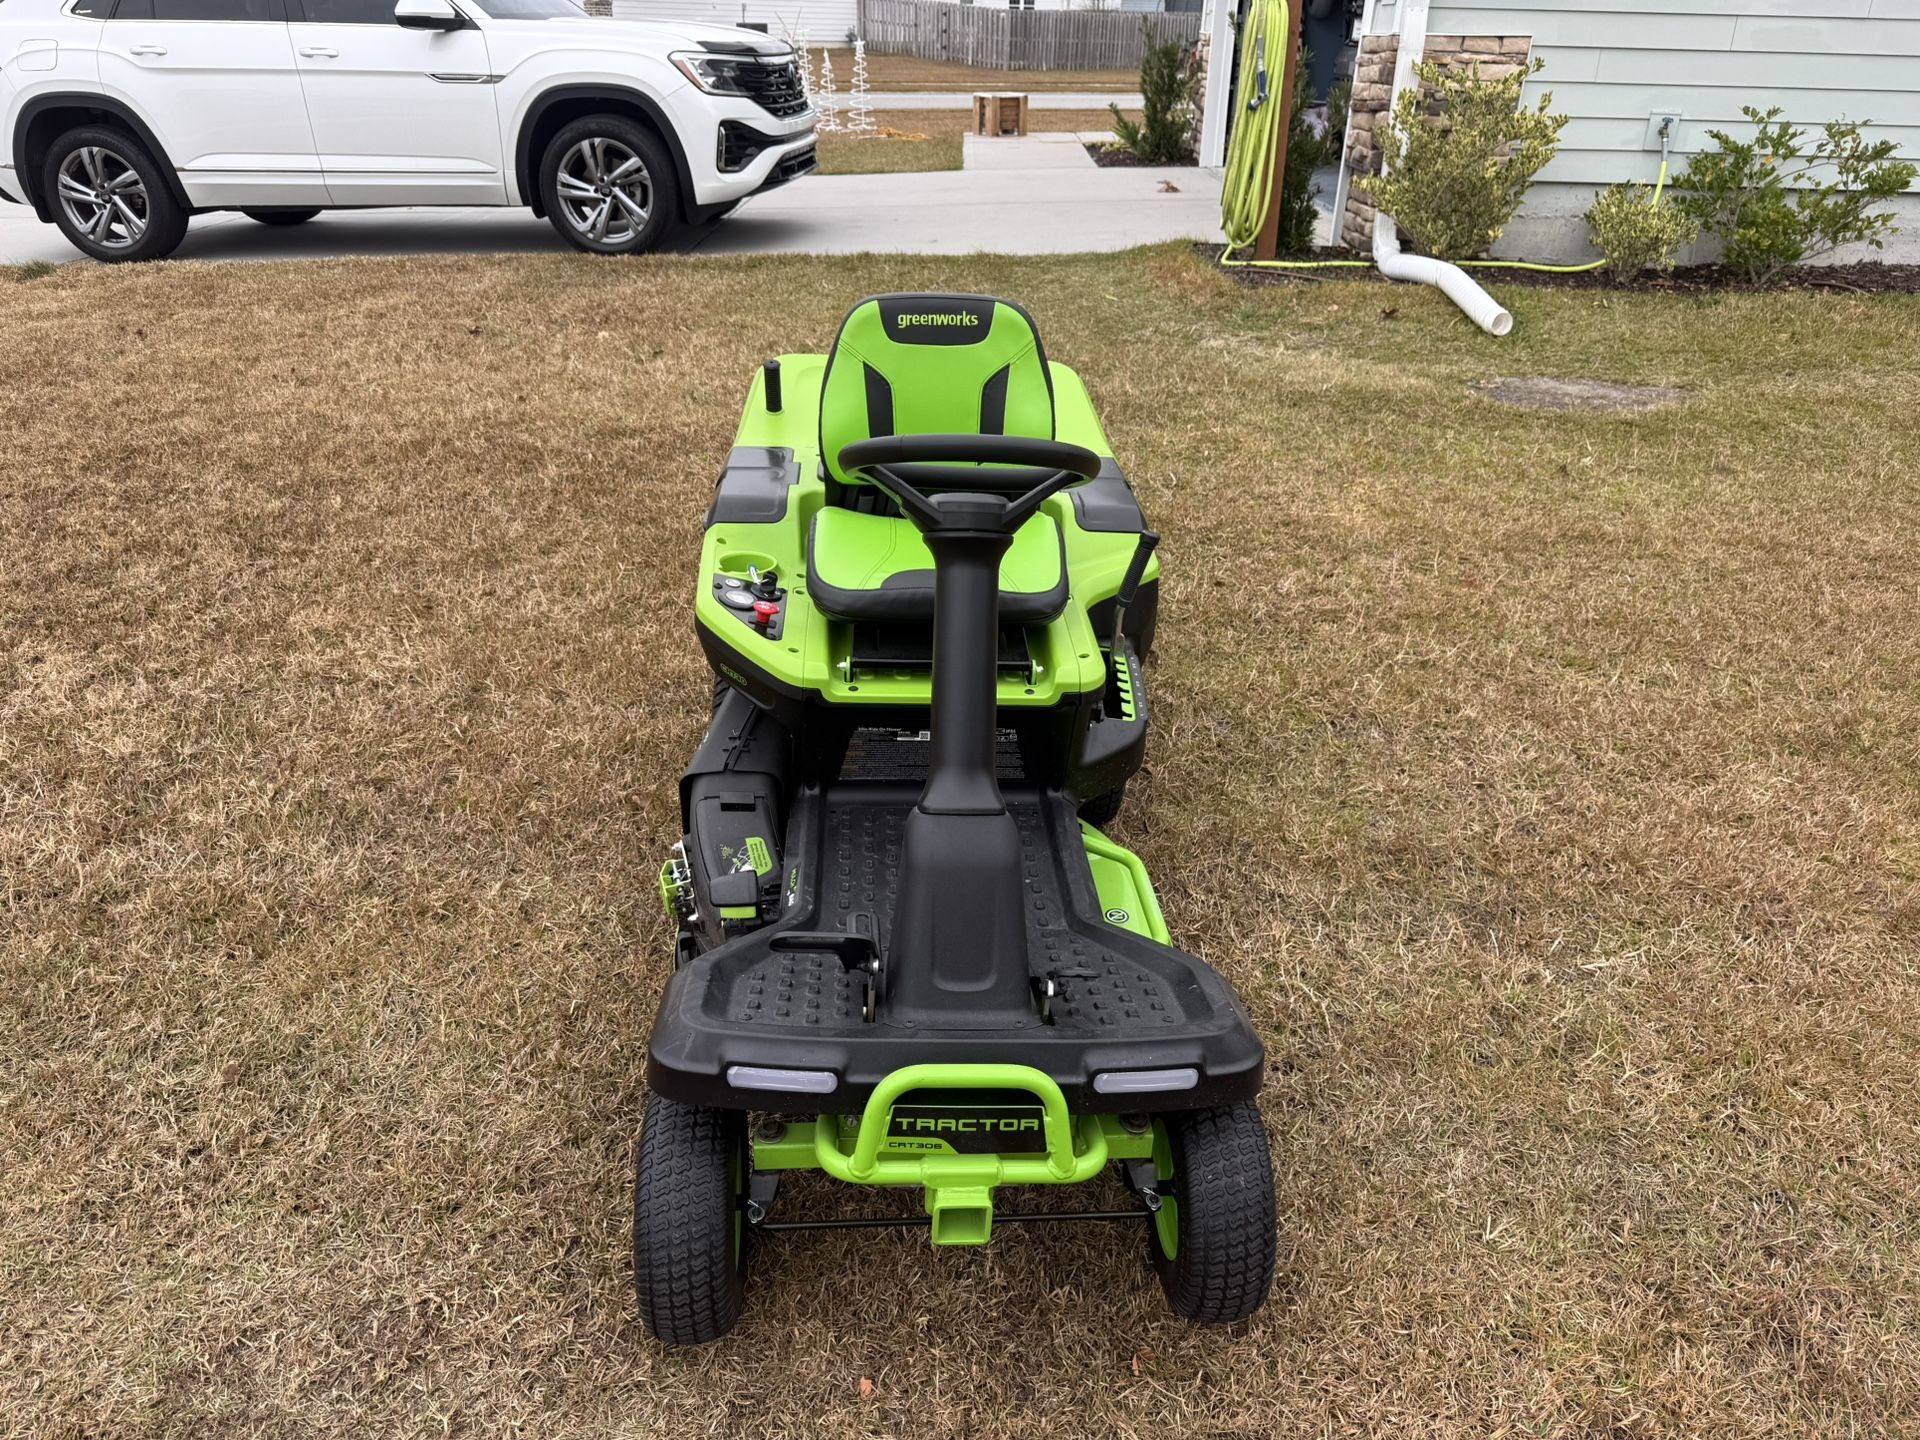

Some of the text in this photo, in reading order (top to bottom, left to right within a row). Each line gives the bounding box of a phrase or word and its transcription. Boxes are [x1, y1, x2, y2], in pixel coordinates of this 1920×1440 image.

[897, 310, 979, 329] greenworks
[895, 1117, 1040, 1132] TRACTOR
[888, 1141, 943, 1150] CRT306
